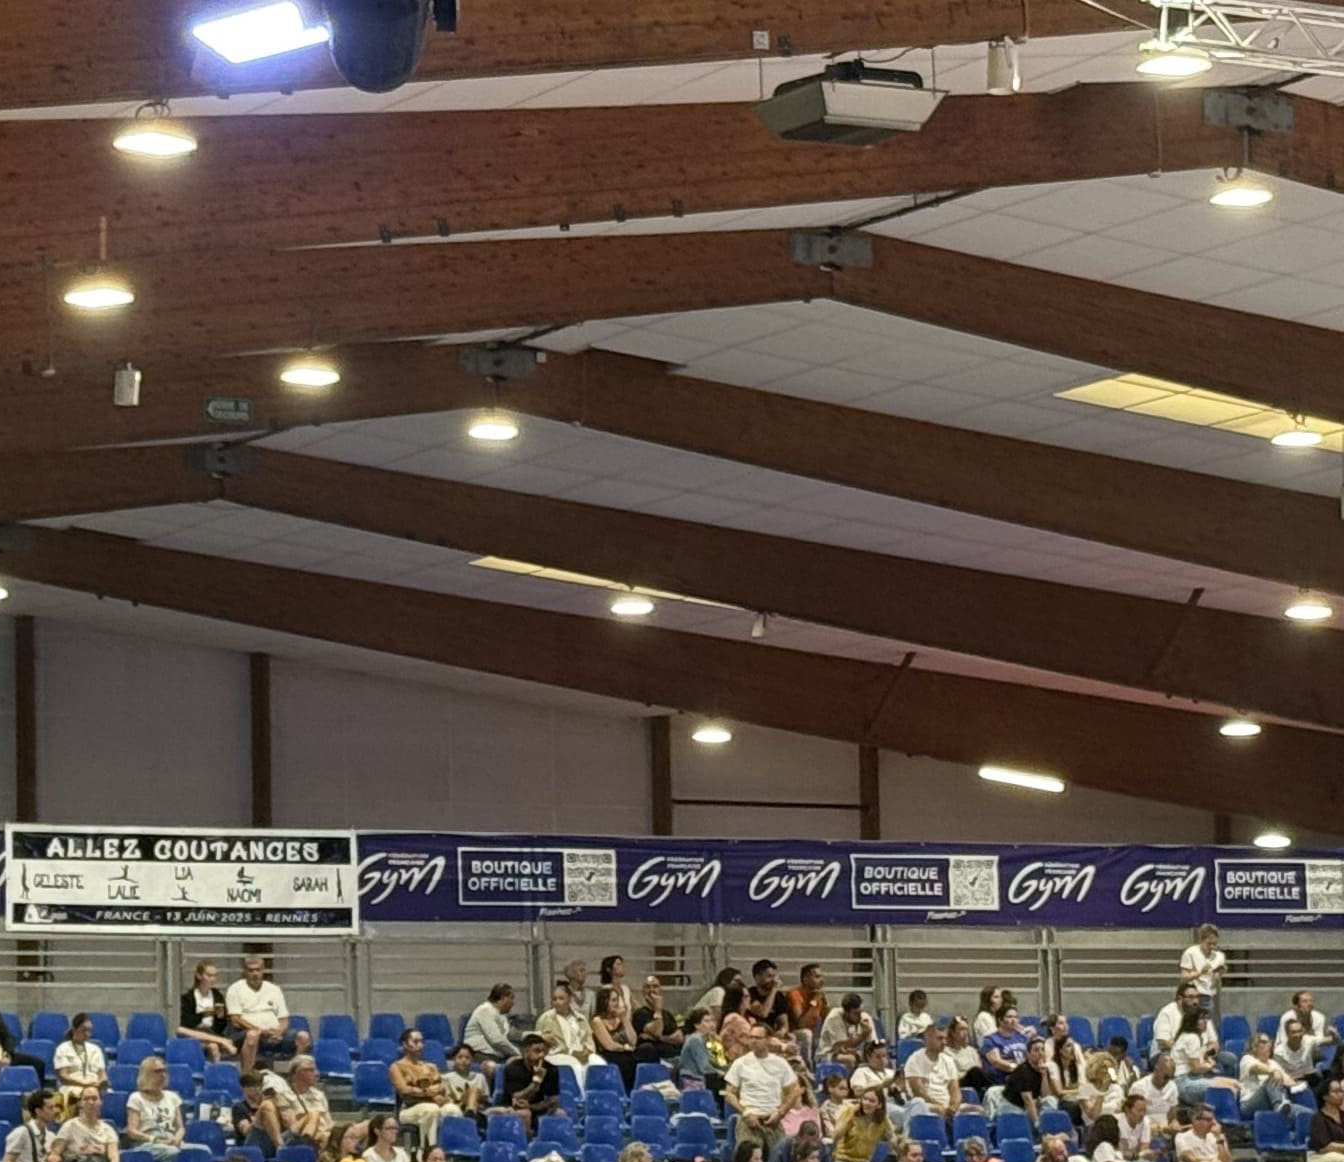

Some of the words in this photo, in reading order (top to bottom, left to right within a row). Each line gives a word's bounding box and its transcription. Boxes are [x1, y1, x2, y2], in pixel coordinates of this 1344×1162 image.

[47, 837, 142, 860] ALLEZ
[154, 839, 320, 863] COUTANCES
[471, 860, 552, 875] BOUTIQUE
[864, 866, 938, 880] BOUTIQUE
[293, 876, 329, 893] SARAH
[467, 877, 557, 892] OFFICIELLE
[1226, 871, 1296, 884] BOUTIQUE
[860, 882, 943, 896] OFFICIELLE
[1223, 886, 1301, 900] OFFICIELLE
[95, 910, 151, 921] FRANCE
[166, 912, 182, 921] 13
[185, 911, 218, 923] JUIN
[220, 912, 252, 923] 2025
[265, 912, 318, 924] RENNES
